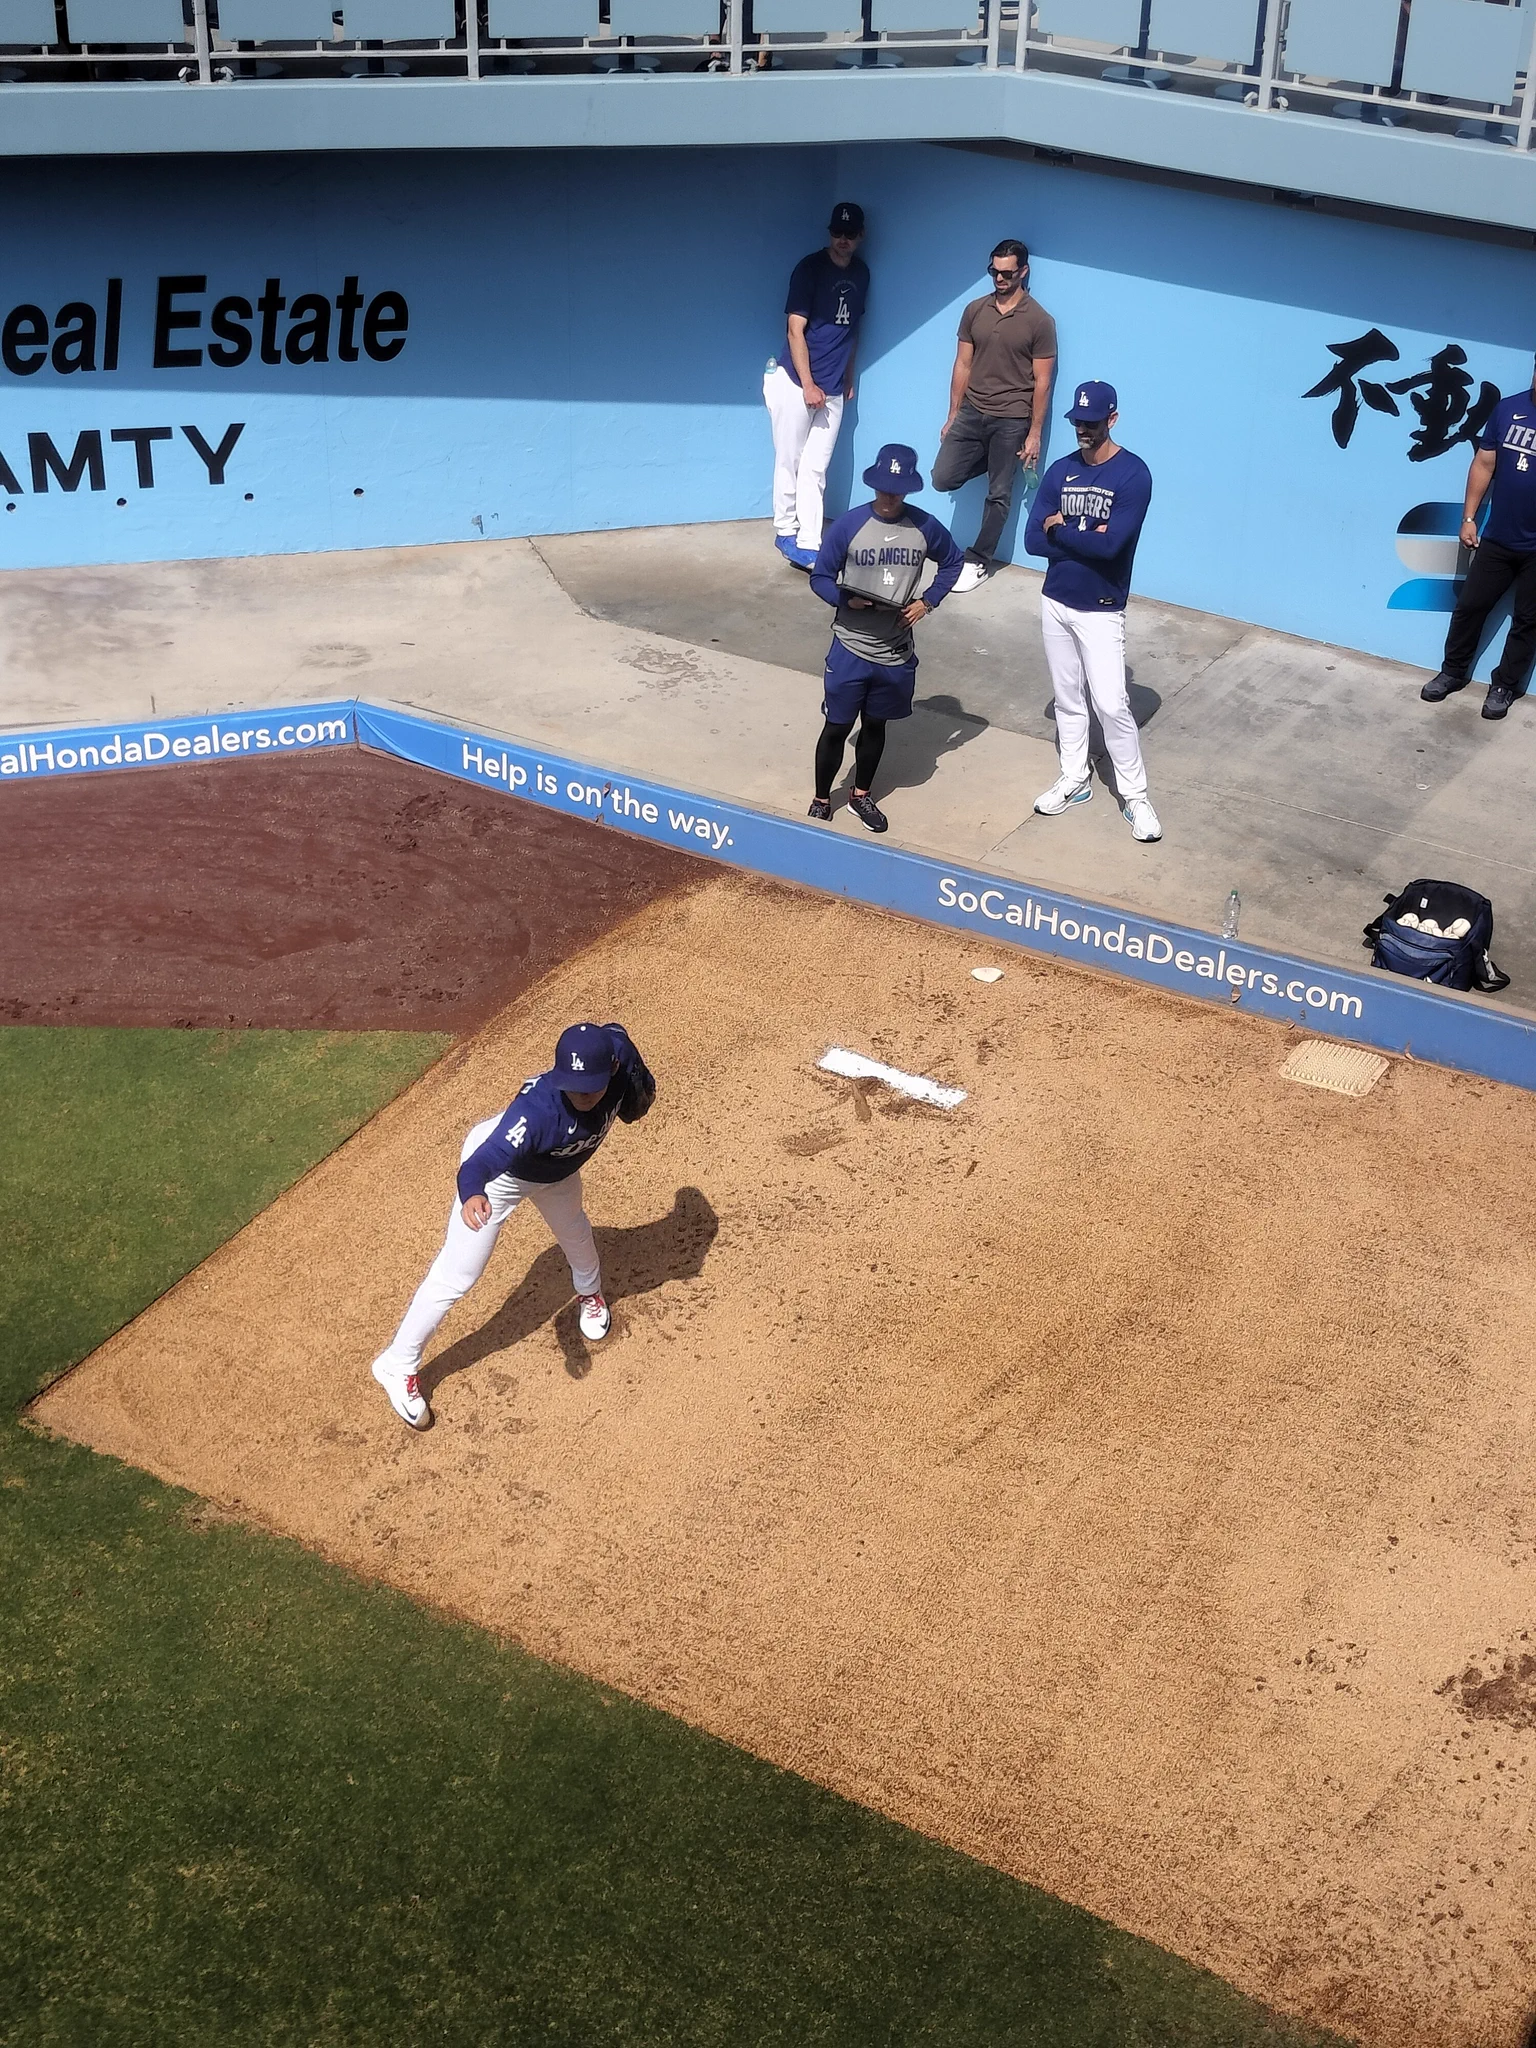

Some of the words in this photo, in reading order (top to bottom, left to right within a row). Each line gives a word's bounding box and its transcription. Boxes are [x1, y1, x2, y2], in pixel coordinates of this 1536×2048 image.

[841, 208, 850, 221] LA
[835, 297, 850, 325] LA
[2, 278, 123, 376] eal
[153, 275, 409, 368] Estate
[1079, 391, 1089, 407] LA
[890, 459, 901, 474] LA
[1516, 453, 1529, 472] LA
[855, 548, 876, 567] LOS
[878, 547, 922, 567] ANGELES
[883, 568, 895, 585] LA
[0, 718, 347, 775] alHondaDealers.com
[462, 743, 527, 791] Help
[536, 764, 558, 795] is
[566, 781, 603, 808] on
[611, 786, 659, 824] the
[668, 808, 734, 851] way.
[938, 877, 1364, 1019] SoCalHondaDealers.com
[571, 1052, 585, 1071] LA
[504, 1115, 528, 1149] LA
